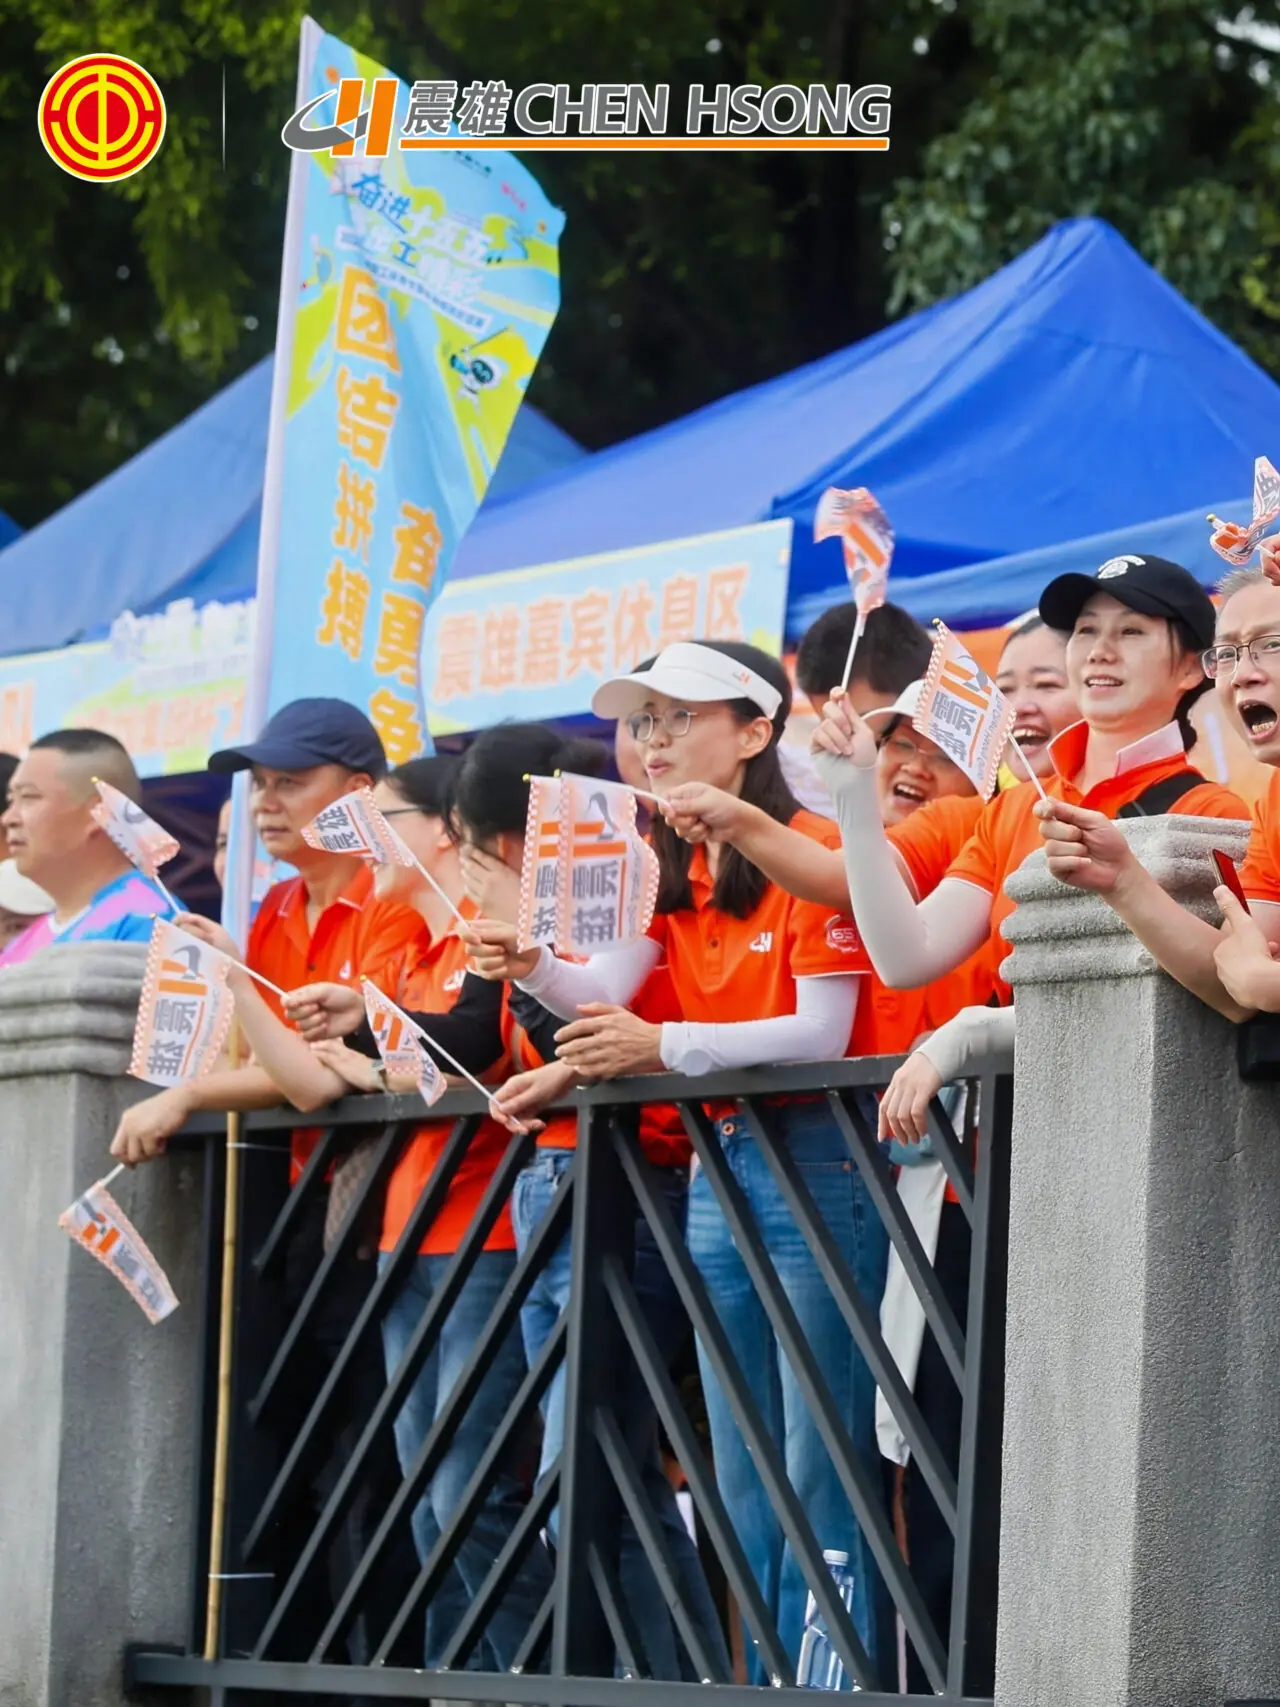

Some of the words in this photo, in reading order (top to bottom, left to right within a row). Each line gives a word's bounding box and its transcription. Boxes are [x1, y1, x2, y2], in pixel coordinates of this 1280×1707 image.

[433, 564, 752, 702] 震雄嘉宾休息区
